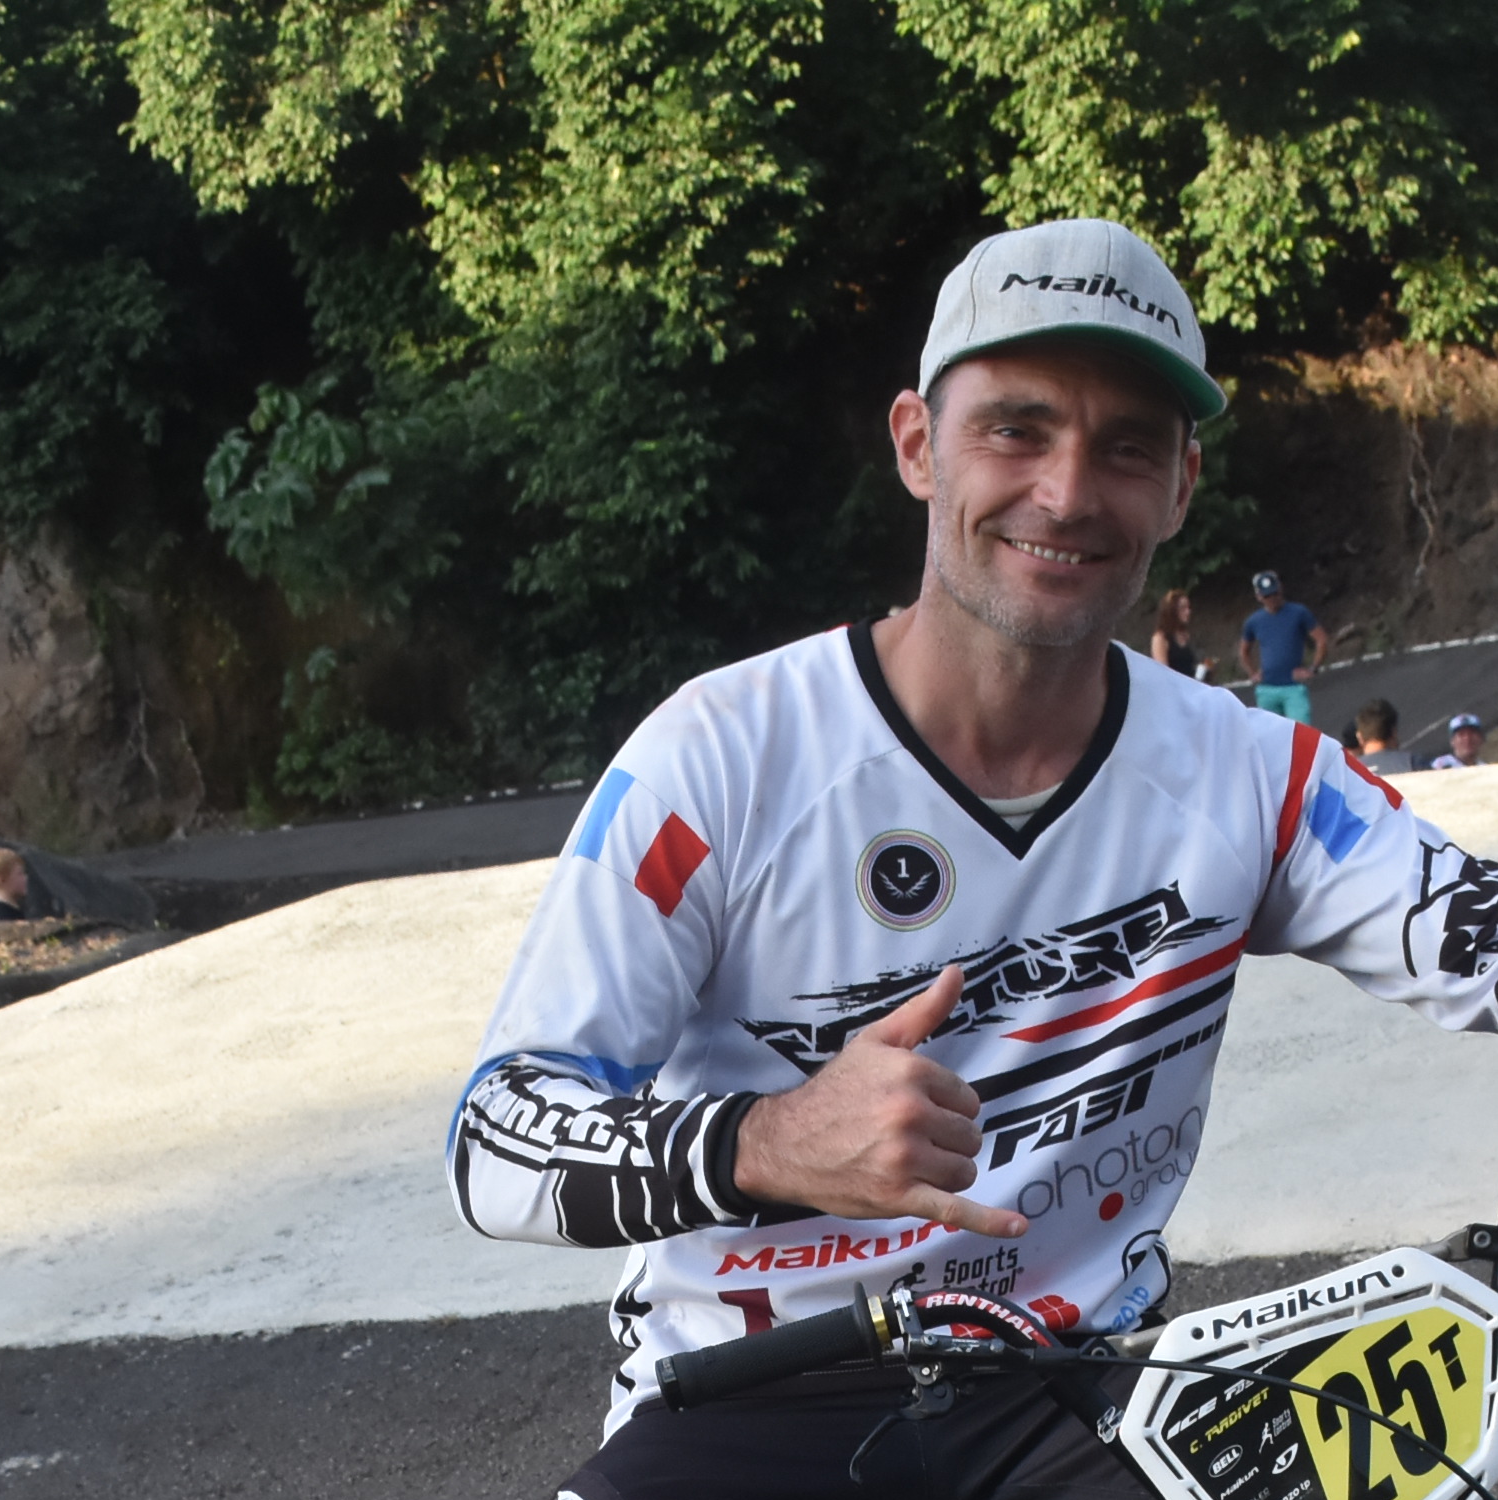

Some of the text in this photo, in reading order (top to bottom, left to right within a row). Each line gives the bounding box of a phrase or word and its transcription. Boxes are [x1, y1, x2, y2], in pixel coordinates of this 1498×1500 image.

[999, 273, 1183, 340] Maikun
[943, 1245, 1019, 1284] Sports
[926, 1293, 1035, 1341] RENTHAL
[1212, 1270, 1392, 1339] Maikun
[1167, 1396, 1218, 1440] ICE
[1212, 1448, 1240, 1475] BELL
[1220, 1466, 1260, 1500] Maikun
